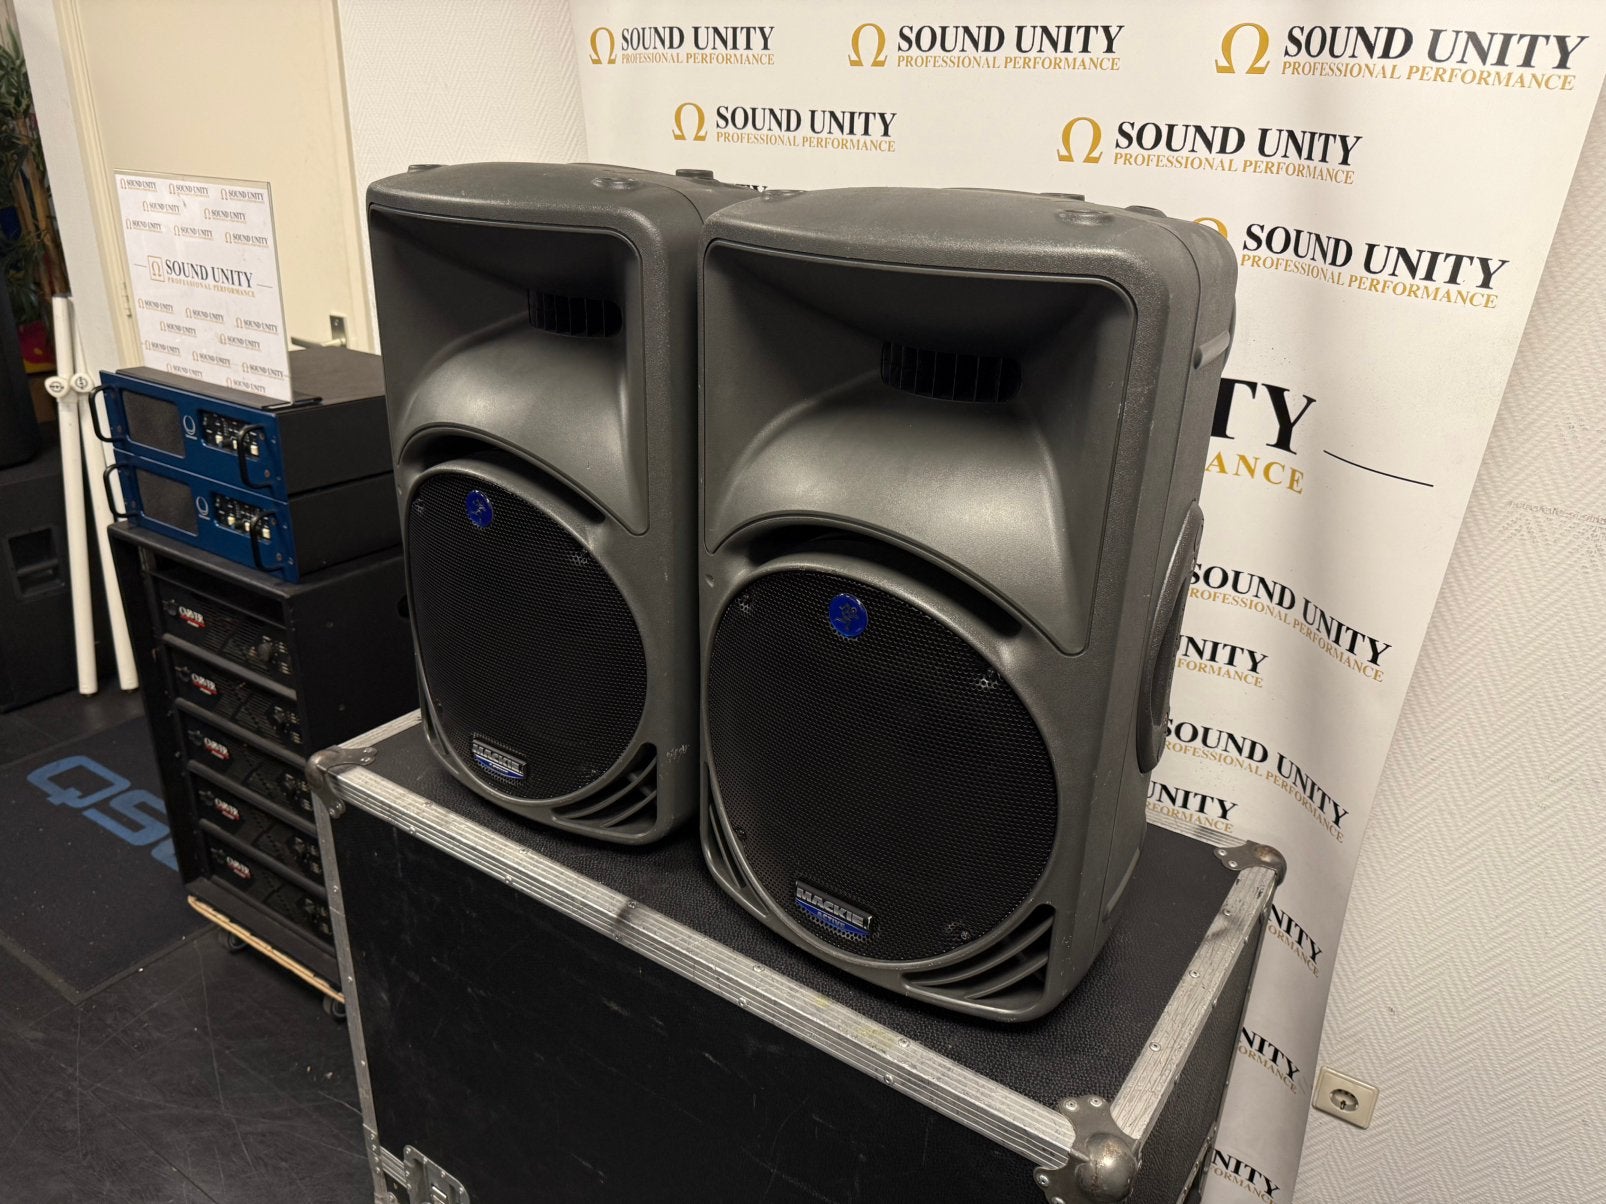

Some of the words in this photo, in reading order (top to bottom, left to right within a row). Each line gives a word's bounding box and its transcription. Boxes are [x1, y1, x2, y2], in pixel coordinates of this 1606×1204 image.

[622, 26, 684, 51] SOUND
[692, 26, 775, 51] UNITY
[622, 52, 683, 64] PROFESSIONAL
[686, 53, 775, 65] PERFORMANCE
[897, 25, 1005, 53] SOUND
[1015, 25, 1125, 54] UNITY
[1283, 25, 1413, 60] SOUND
[1427, 28, 1589, 70] UNITY
[897, 55, 1000, 69] PROFESSIONAL
[1004, 56, 1120, 71] PERFORMANCE
[1281, 61, 1401, 79] PROFESSIONAL
[1406, 65, 1576, 91] PERFORMANCE
[716, 105, 802, 133] SOUND
[808, 110, 897, 138] UNITY
[717, 132, 799, 147] PROFESSIONAL
[802, 136, 896, 153] PERFORMANCE
[1115, 121, 1245, 155] SOUND
[1258, 128, 1363, 166] UNITY
[1113, 152, 1238, 173] PROFESSIONAL
[1242, 159, 1355, 185] PERFORMANCE
[165, 259, 208, 280] SOUND
[210, 266, 253, 288] UNITY
[1242, 223, 1353, 268] SOUND
[1363, 242, 1510, 290] UNITY
[1240, 254, 1345, 286] PROFESSIONAL
[1348, 274, 1499, 309] PERFORMANCE
[1189, 587, 1291, 626] ROFESSIONAL
[1292, 618, 1384, 683] PERFORMANCE
[1190, 563, 1296, 610] SOUND
[1302, 597, 1392, 667] UNITY
[1177, 657, 1264, 688] FORMANCE
[1179, 634, 1268, 674] NITY
[472, 743, 521, 773] MACKIE
[1165, 741, 1262, 777] ROFESSIONAL
[1265, 769, 1344, 844] PERFORMANCE
[1277, 752, 1349, 828] UNITY
[27, 755, 180, 872] QS
[796, 887, 865, 928] MACKIE
[1268, 903, 1322, 965] NITY
[1268, 924, 1319, 978] ORMANCE
[1239, 1045, 1297, 1095] ORMANCE
[1242, 1026, 1300, 1082] NITY
[1211, 1149, 1280, 1199] NITY
